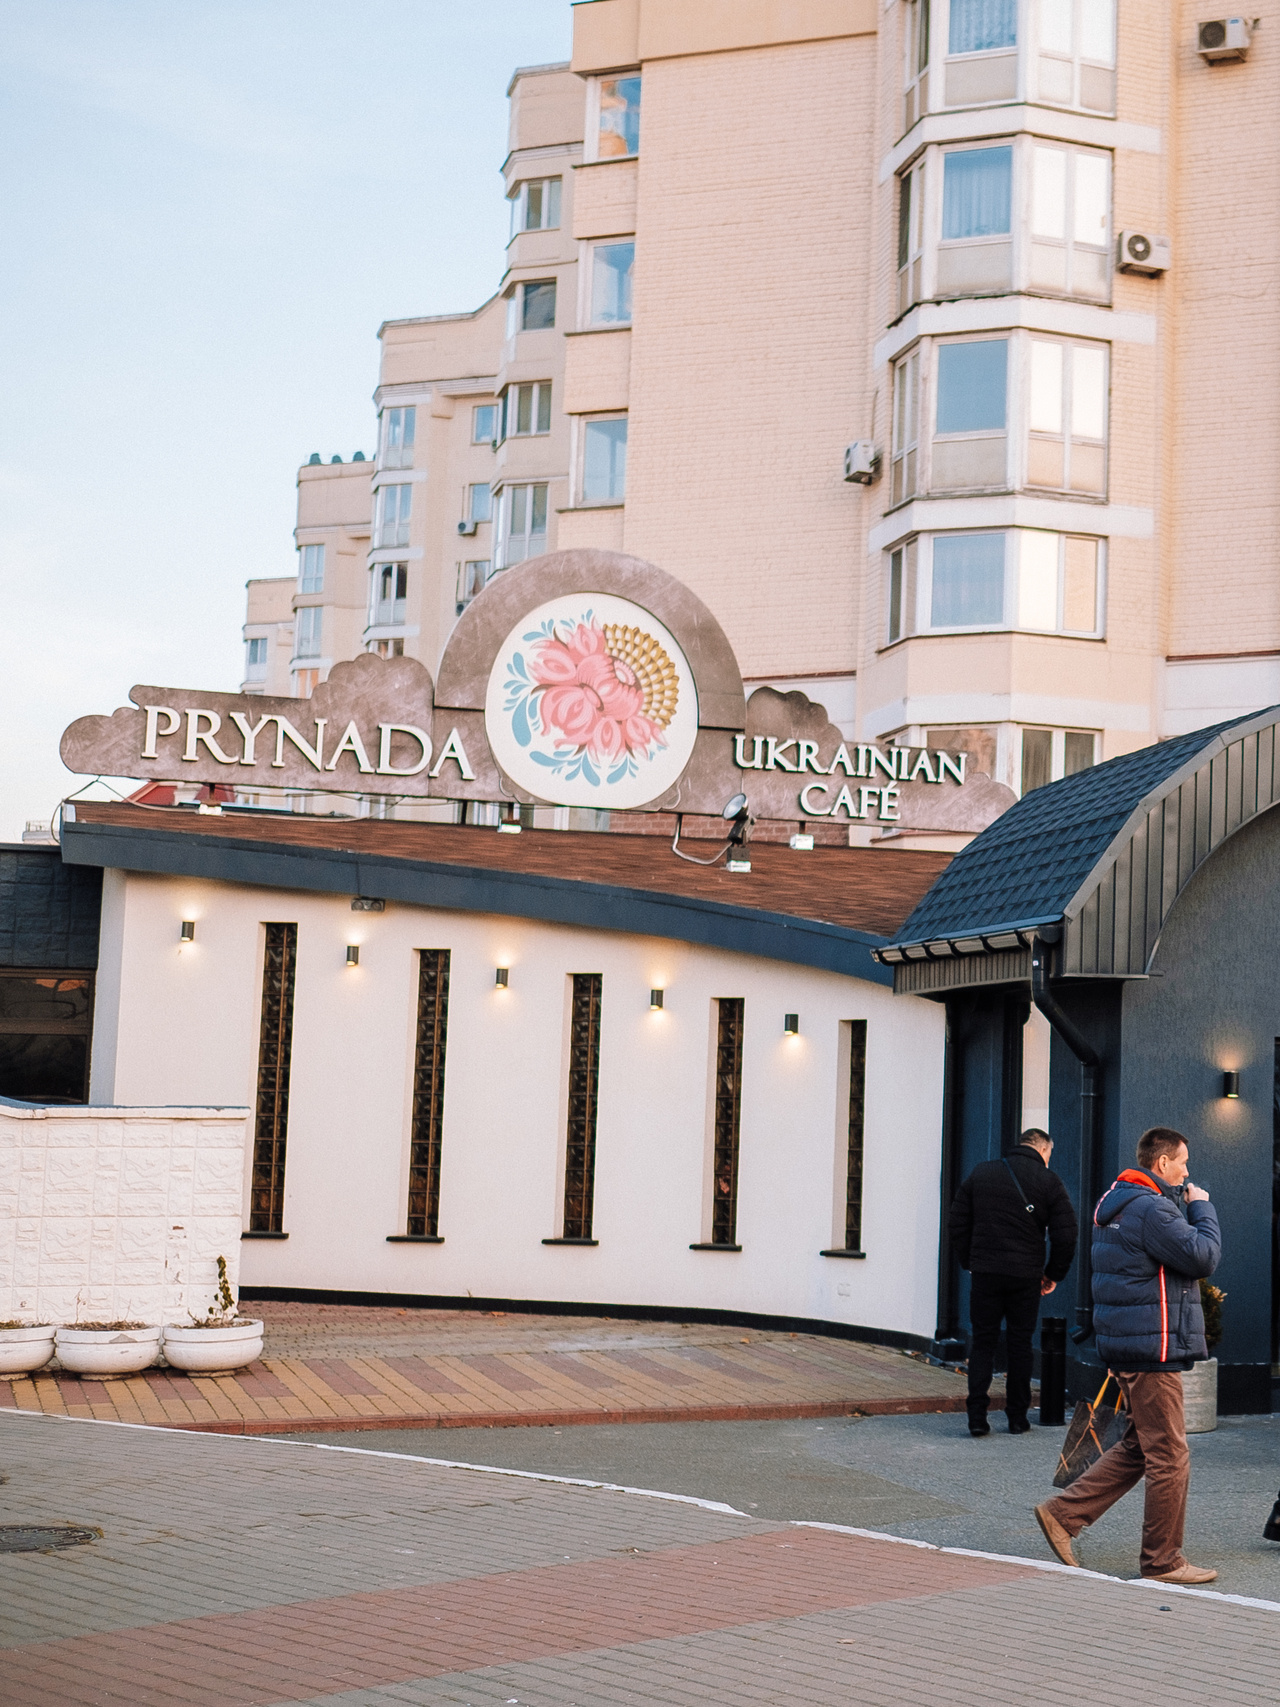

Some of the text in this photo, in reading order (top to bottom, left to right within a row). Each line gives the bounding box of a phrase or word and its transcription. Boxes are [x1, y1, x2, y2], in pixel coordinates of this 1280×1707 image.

[141, 705, 476, 780] PRYNADA
[735, 734, 968, 785] UKRAINIAN
[800, 780, 901, 820] CAFÉ
